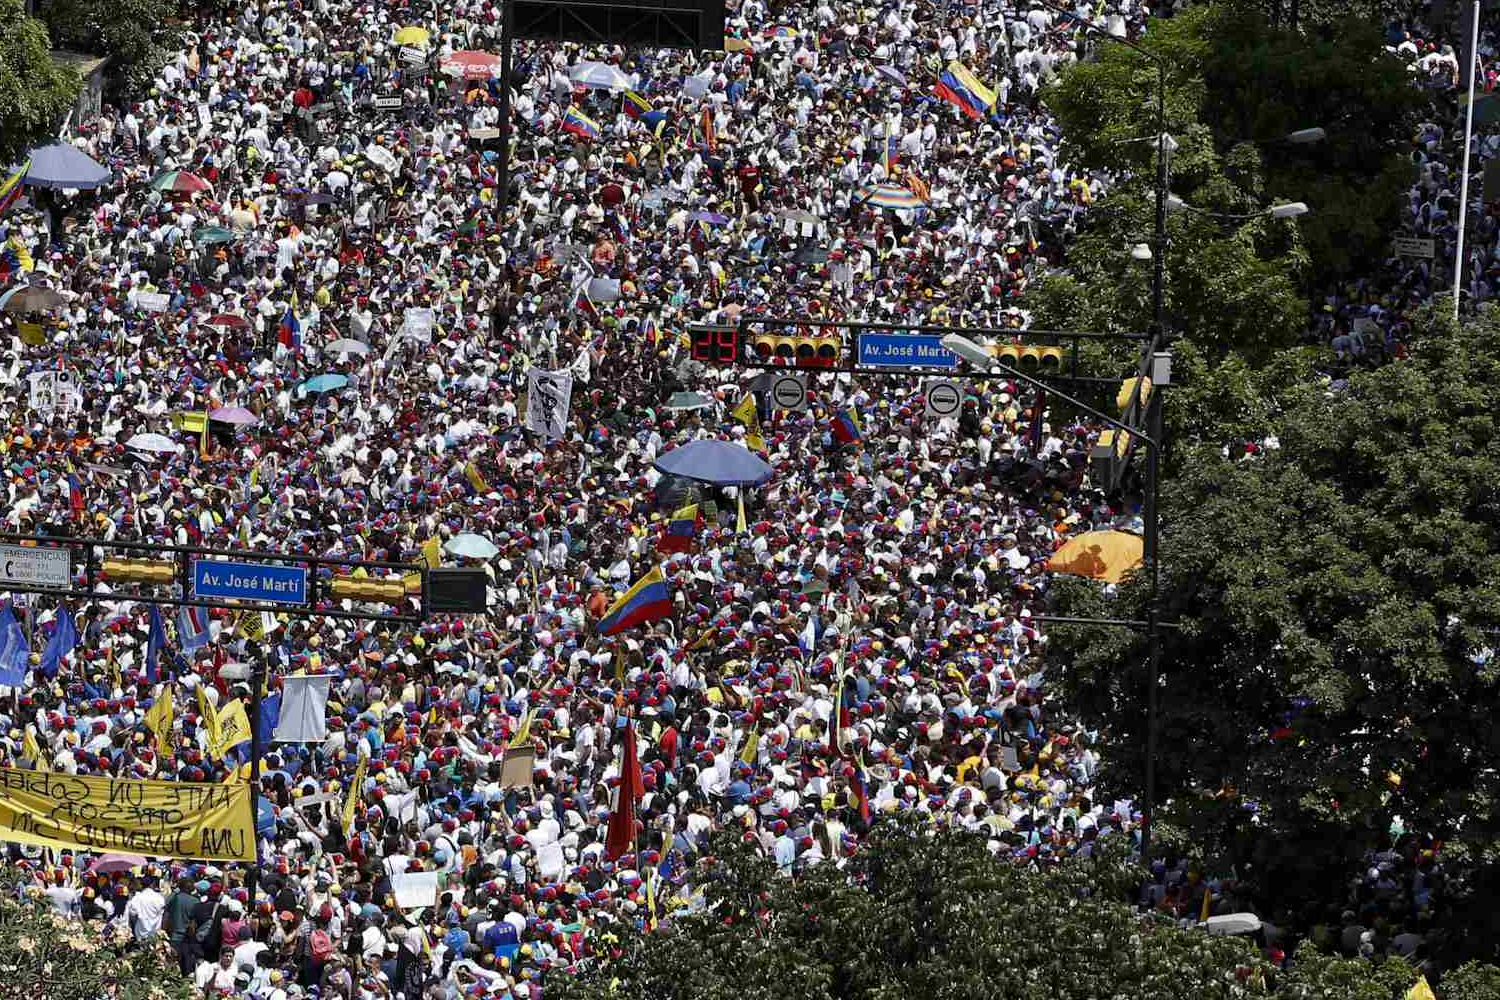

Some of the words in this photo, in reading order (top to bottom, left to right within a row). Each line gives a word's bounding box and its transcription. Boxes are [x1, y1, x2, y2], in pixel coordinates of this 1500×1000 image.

[864, 343, 882, 355] Av.
[884, 343, 914, 356] José
[202, 571, 221, 586] Av.
[224, 573, 258, 589] José
[262, 576, 300, 593] Martí
